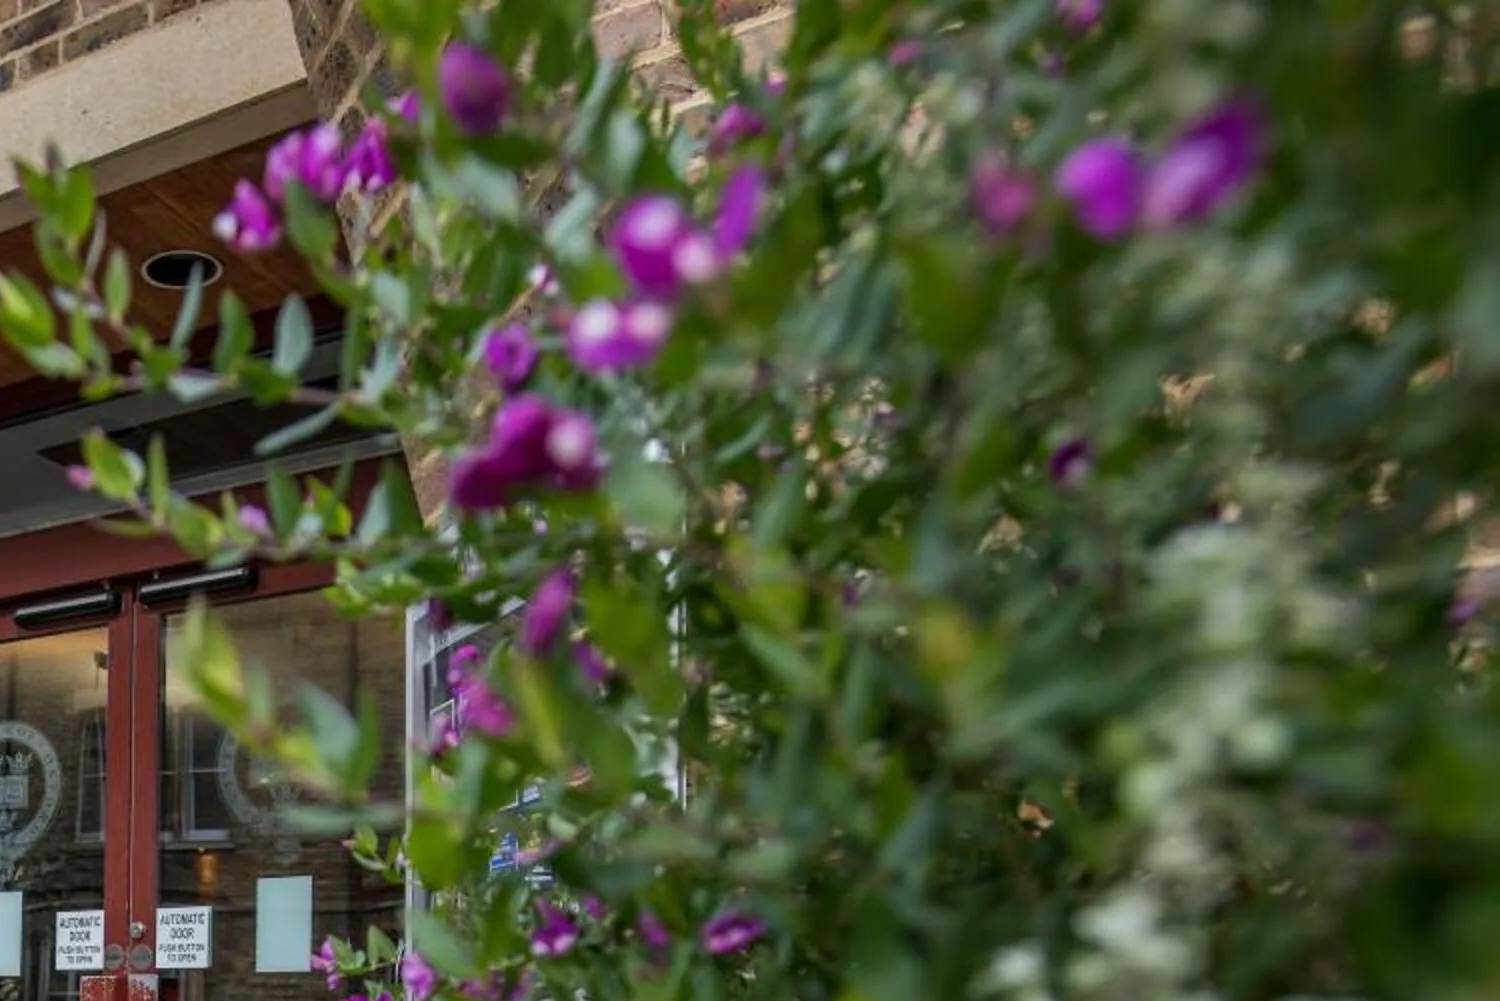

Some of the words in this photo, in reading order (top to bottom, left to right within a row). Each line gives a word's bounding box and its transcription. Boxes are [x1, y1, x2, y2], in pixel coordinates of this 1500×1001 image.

[60, 915, 101, 929] AUTOMATIC
[160, 912, 205, 925] AUTOMATIC
[69, 930, 91, 942] DOOR
[170, 927, 195, 940] DOOR
